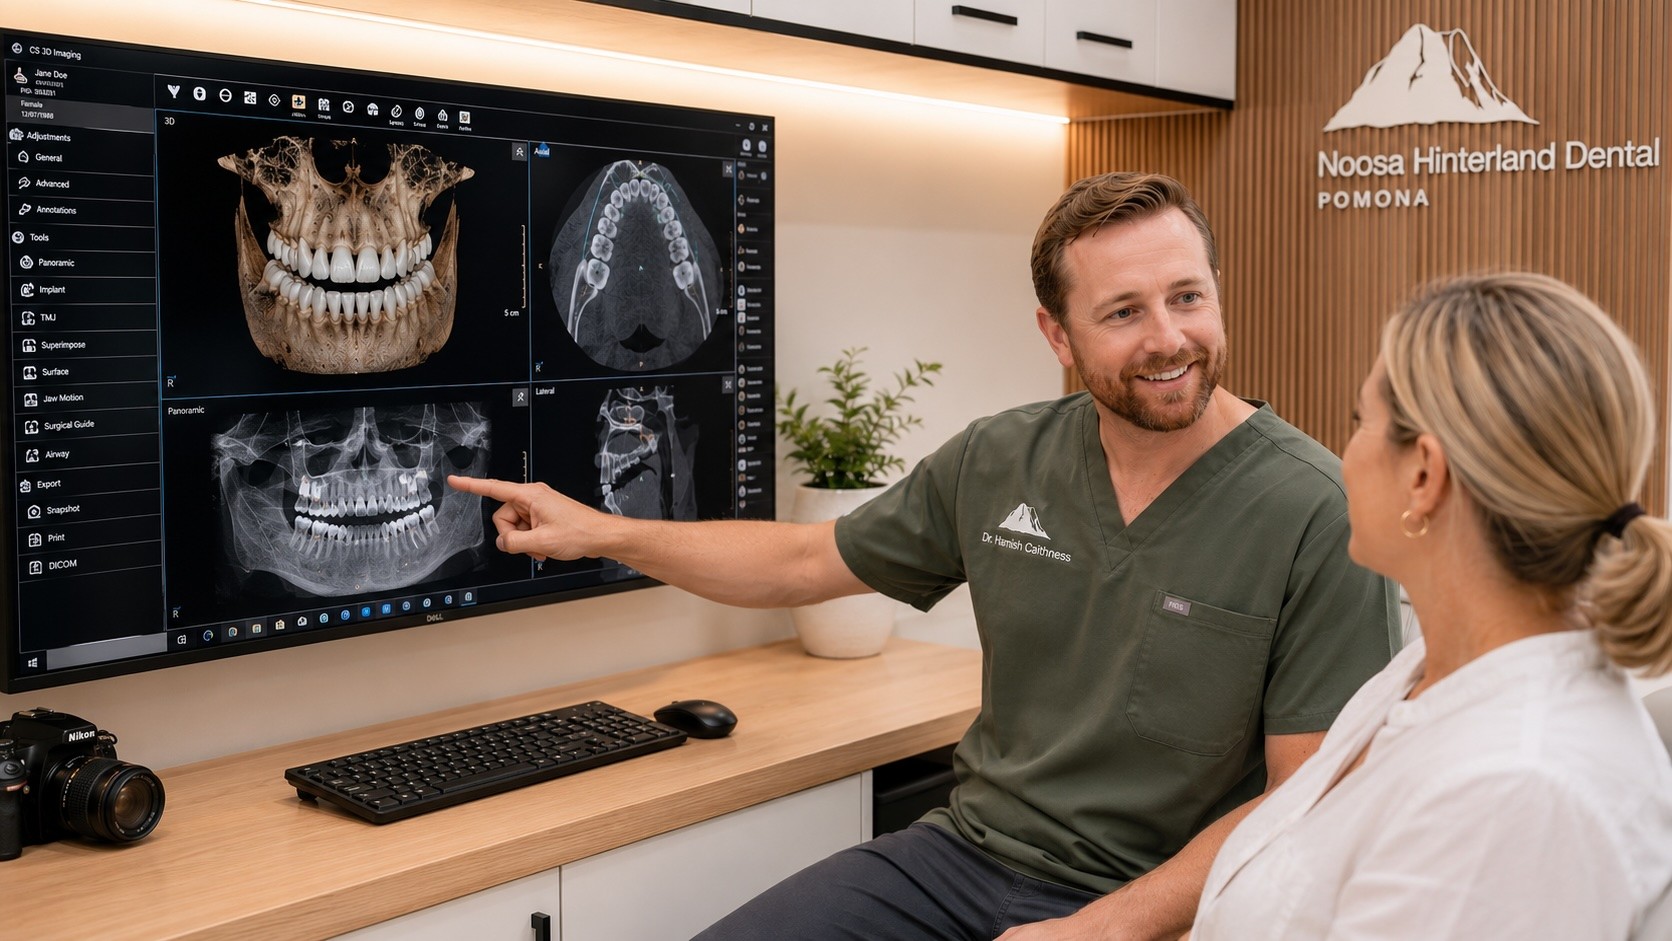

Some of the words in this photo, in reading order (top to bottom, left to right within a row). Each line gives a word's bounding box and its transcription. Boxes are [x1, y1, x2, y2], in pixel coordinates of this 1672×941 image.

[30, 46, 40, 54] CS
[54, 48, 82, 60] Imaging
[35, 69, 52, 78] Jane
[54, 70, 68, 79] Doe
[164, 117, 175, 126] 3D
[27, 132, 71, 142] Adjustments
[36, 153, 62, 162] General
[1318, 150, 1405, 178] Noosa
[1413, 141, 1556, 175] Hinterland
[1565, 137, 1661, 171] Dental
[36, 179, 70, 188] Advanced
[1318, 189, 1430, 210] POMONA
[36, 206, 76, 215] Annotations
[30, 234, 49, 242] Tools
[38, 259, 75, 268] Panoramic
[40, 286, 66, 295] Implant
[42, 341, 86, 350] Superimpose
[42, 368, 69, 376] Surface
[168, 378, 174, 388] R
[536, 387, 555, 395] Lateral
[59, 394, 84, 402] Motion
[168, 406, 205, 415] Panoramic
[44, 421, 72, 432] Surgical
[74, 420, 94, 429] Guide
[46, 450, 70, 460] Airway
[37, 480, 61, 490] Export
[46, 504, 80, 515] Snapshot
[48, 534, 65, 542] Print
[982, 532, 993, 544] Dr.
[994, 534, 1022, 552] Hamish
[1025, 542, 1072, 562] Caithness
[49, 560, 77, 570] DICOM
[172, 610, 179, 618] R
[68, 730, 96, 742] Nikon
